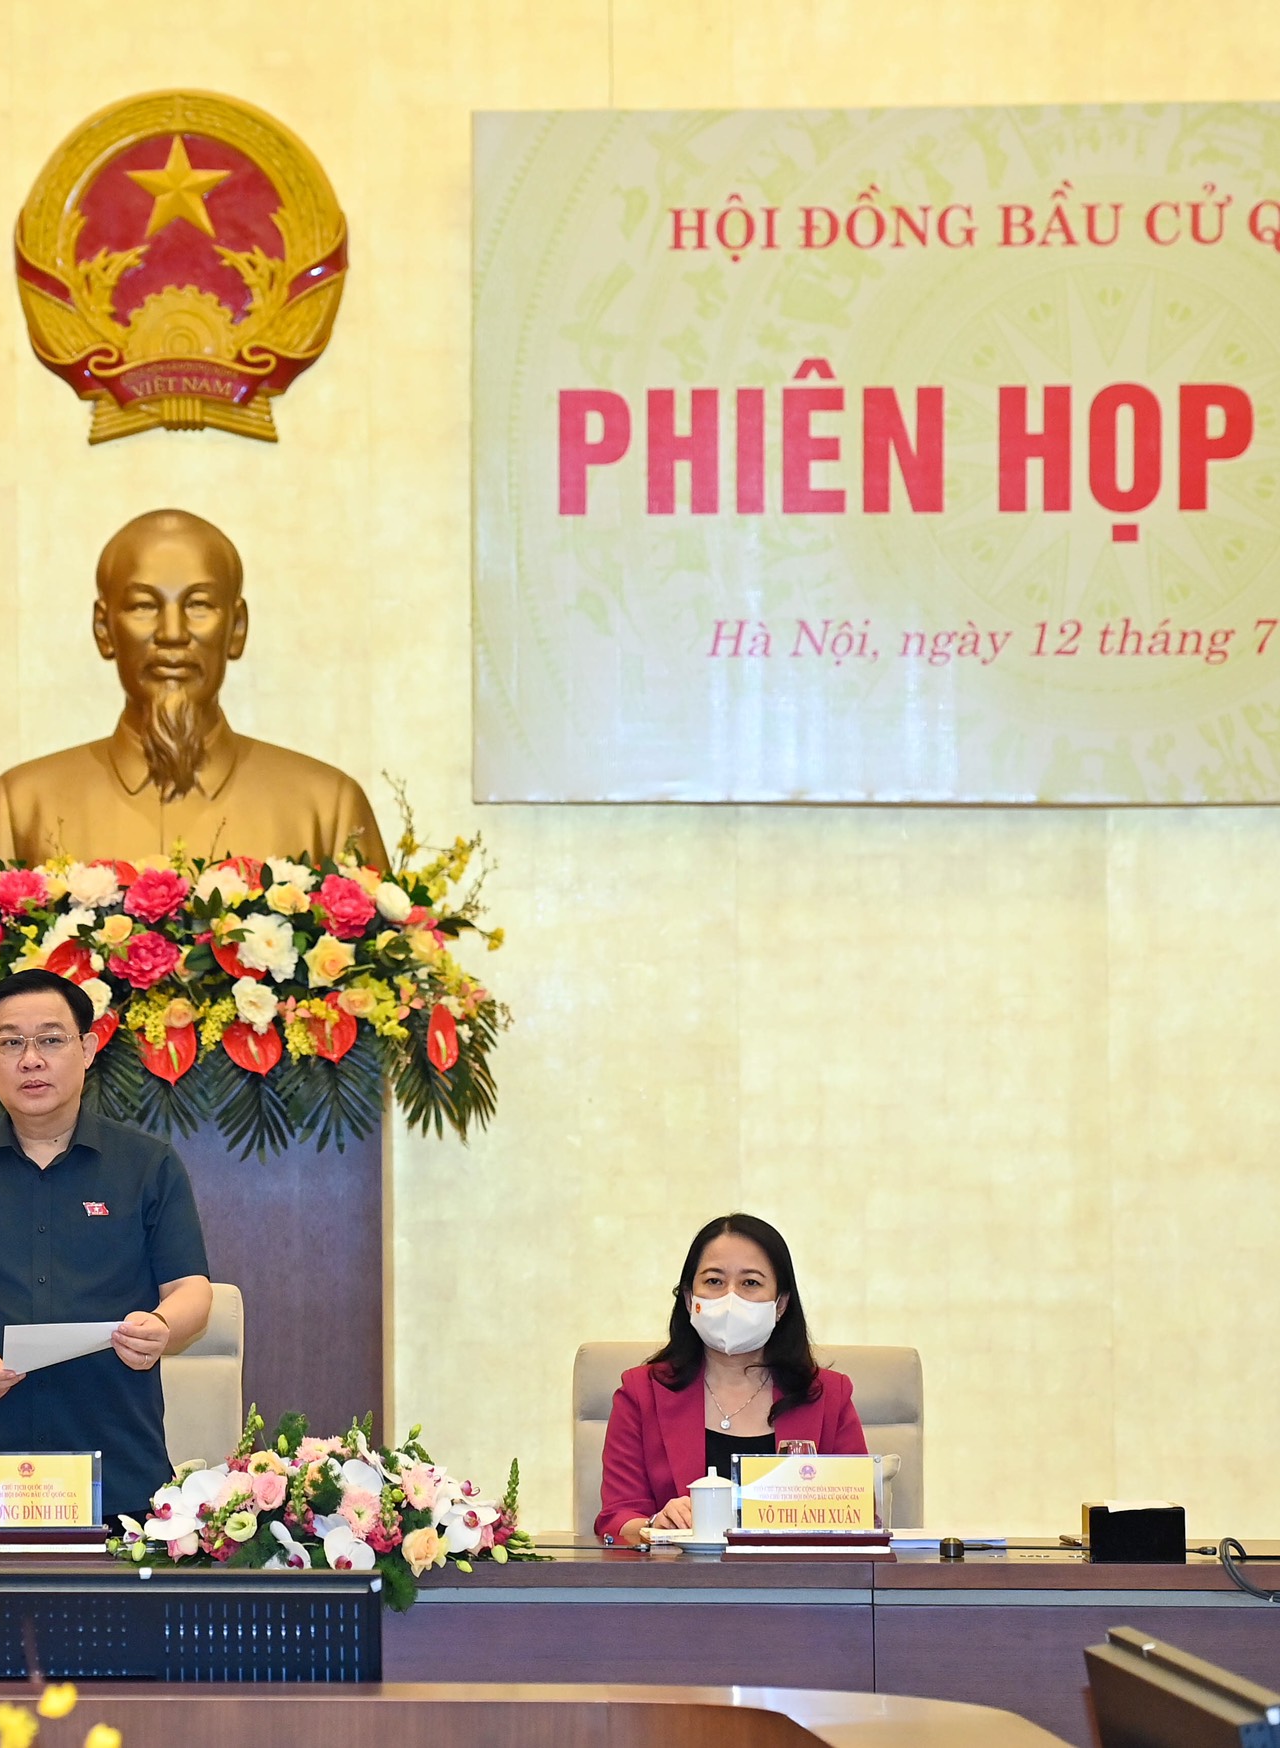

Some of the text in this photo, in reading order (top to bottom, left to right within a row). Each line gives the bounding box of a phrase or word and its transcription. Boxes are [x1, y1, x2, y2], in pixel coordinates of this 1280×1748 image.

[669, 192, 780, 263] HỘI
[799, 183, 977, 250] ĐỒNG
[997, 180, 1124, 248] BẦU
[1145, 182, 1232, 246] CỬ
[181, 376, 234, 398] NAM
[558, 358, 1256, 543] PHIÊN HỌP
[706, 616, 1279, 667] Hà Nội, ngày 12 tháng 7
[22, 1501, 51, 1520] ĐÌNH
[55, 1502, 79, 1524] HUỆ
[758, 1504, 861, 1527] VÕ THỊ ÁNH XUÂN
